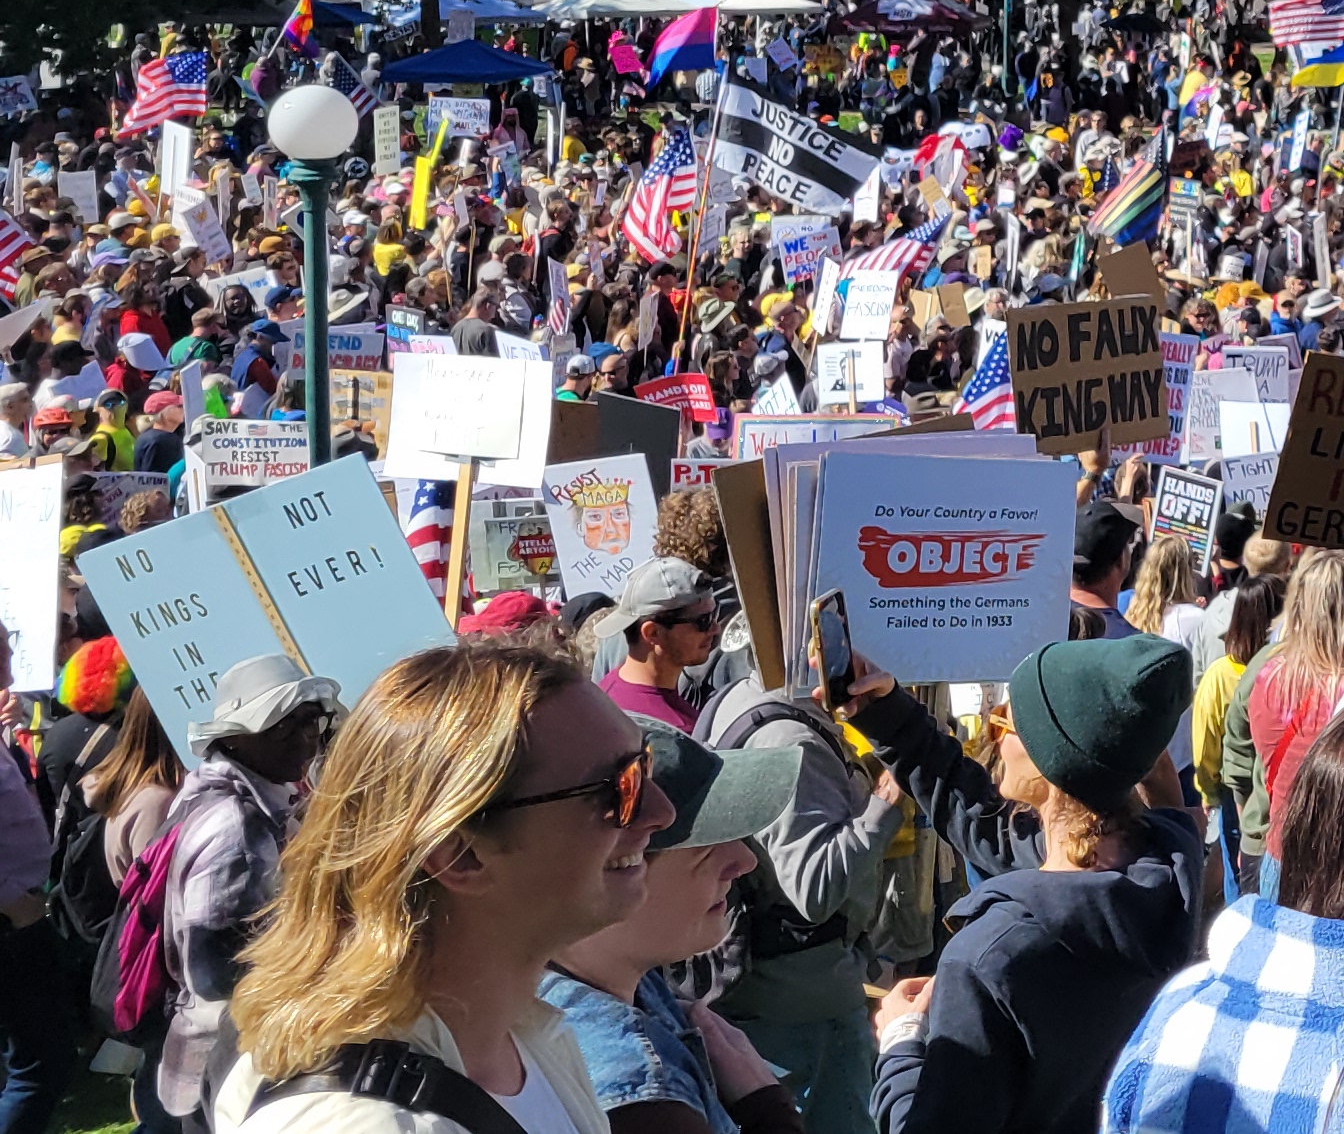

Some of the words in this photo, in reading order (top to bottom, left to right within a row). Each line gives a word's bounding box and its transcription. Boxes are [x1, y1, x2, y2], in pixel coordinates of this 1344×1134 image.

[751, 99, 847, 163] JUSTICE
[768, 134, 795, 166] NO
[741, 152, 812, 203] PEACE
[784, 237, 810, 254] WE
[784, 246, 840, 267] PEOPE
[846, 301, 891, 317] FASCISM
[294, 333, 363, 351] DEND
[1017, 319, 1060, 371] NO
[1067, 305, 1158, 362] FAUX
[1226, 354, 1286, 381] TRUMP
[644, 385, 688, 403] HANDS
[689, 384, 708, 395] OFF
[1259, 380, 1270, 394] A
[204, 422, 238, 434] SAVE
[280, 424, 304, 433] THE
[213, 437, 307, 449] CONSTITUTION
[231, 451, 279, 463] RESIST
[209, 462, 258, 477] TRUMP
[264, 462, 308, 477] FASCISM
[1226, 458, 1274, 480] FIGHT
[550, 468, 601, 506] RESIST
[581, 490, 622, 505] MAGA
[1164, 477, 1215, 502] HANDS
[1233, 486, 1270, 504] NOT
[283, 491, 333, 529] NOT
[874, 505, 895, 517] Do
[899, 506, 931, 519] Your
[934, 507, 986, 522] Country
[989, 510, 997, 519] a
[1000, 507, 1039, 521] Favor!
[1161, 494, 1209, 527] OFF!
[518, 537, 553, 549] STELLA
[115, 548, 154, 582] NO
[571, 552, 602, 579] THE
[887, 540, 1024, 574] OBJECT
[287, 545, 385, 598] EVER!
[600, 557, 634, 590] MAD
[869, 596, 946, 611] Something
[950, 596, 971, 609] the
[975, 596, 1030, 608] Germans
[130, 593, 208, 638] KINGS
[887, 616, 928, 628] Failed
[933, 616, 946, 628] to
[950, 616, 968, 628] Do
[971, 616, 983, 628] in
[986, 615, 1013, 628] 1933
[173, 641, 205, 672] IN
